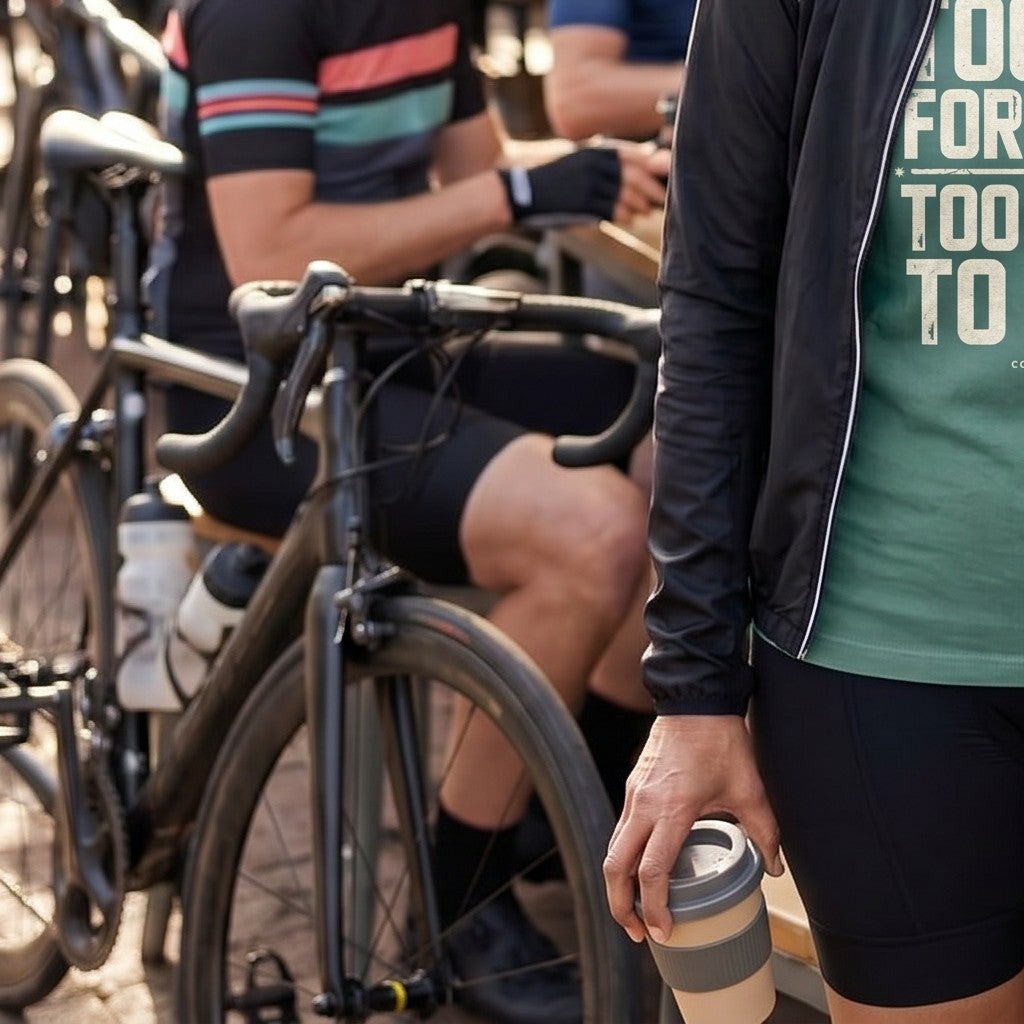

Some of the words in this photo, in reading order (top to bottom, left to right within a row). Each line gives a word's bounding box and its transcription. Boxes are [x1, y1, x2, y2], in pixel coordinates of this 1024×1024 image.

[903, 88, 1023, 160] FOR
[901, 184, 1019, 252] TOO
[906, 258, 1006, 346] TO
